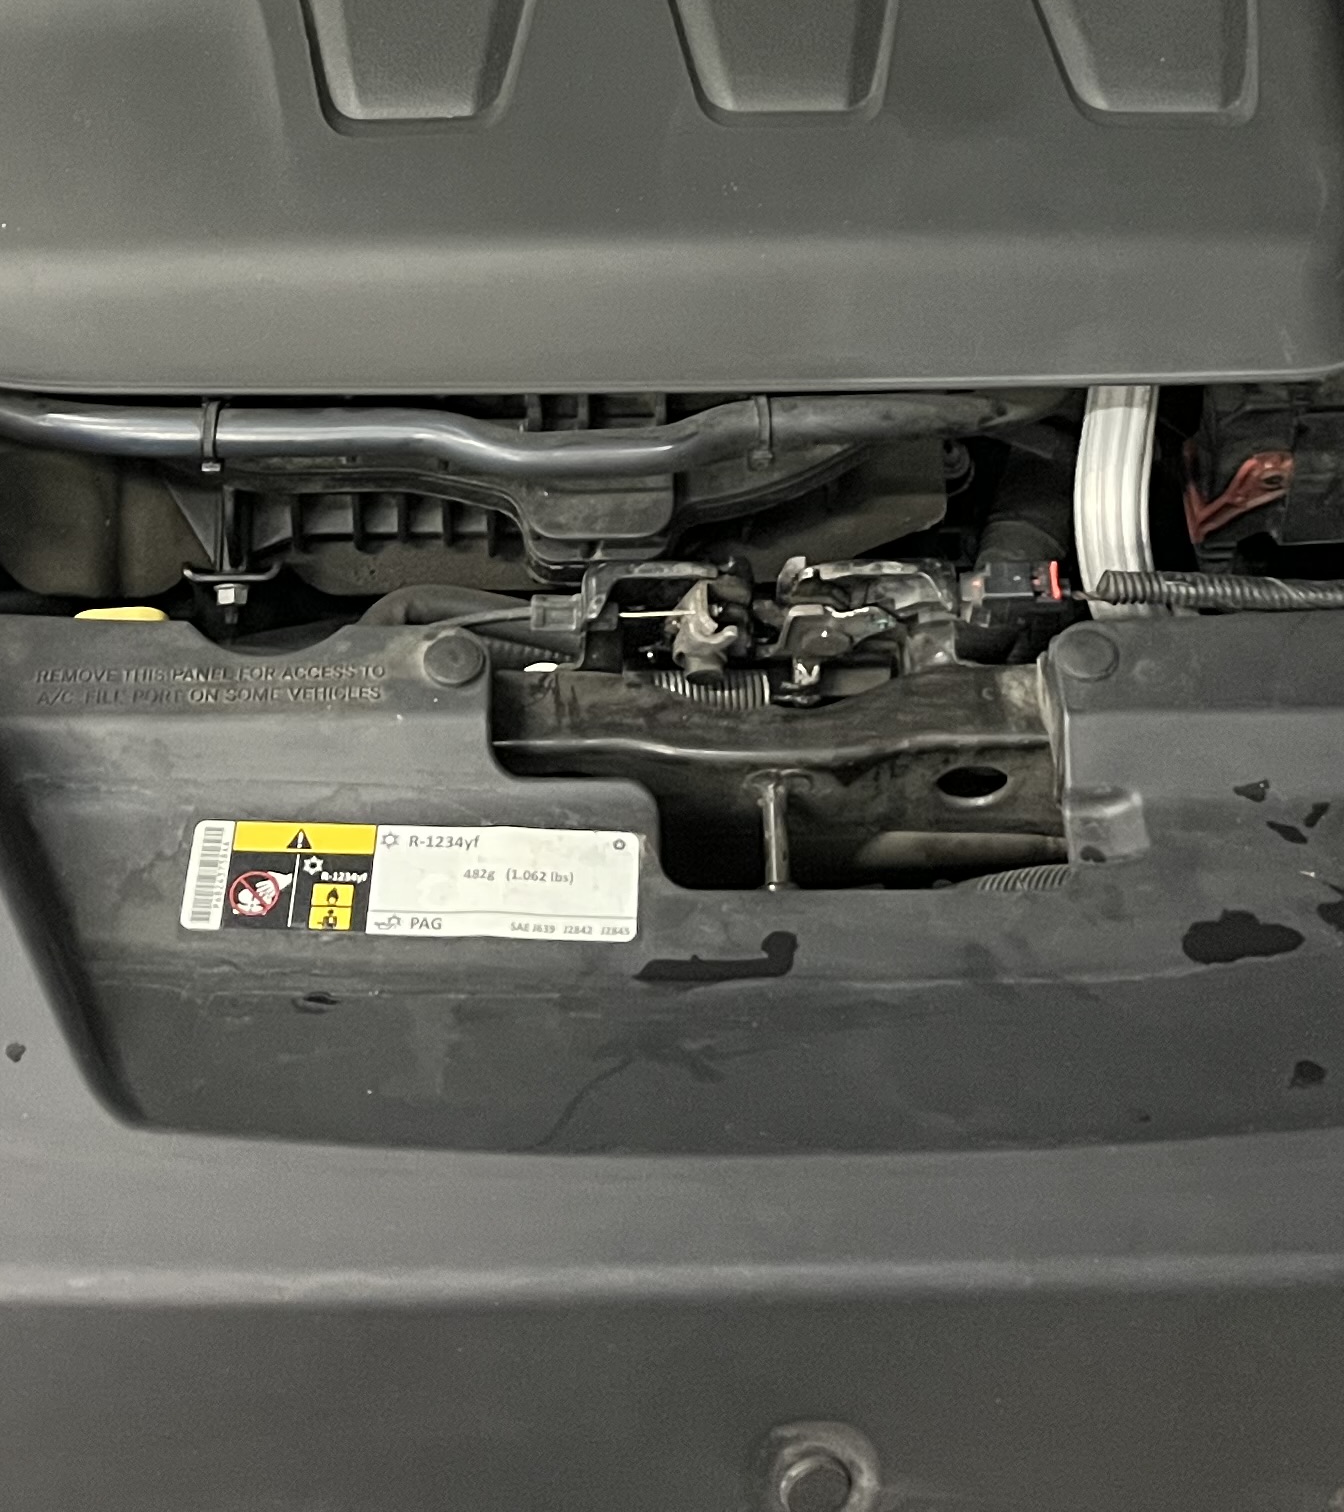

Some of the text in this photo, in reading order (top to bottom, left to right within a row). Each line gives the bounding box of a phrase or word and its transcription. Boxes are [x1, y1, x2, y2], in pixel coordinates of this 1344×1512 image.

[36, 668, 118, 683] REMOVE
[171, 666, 233, 682] PANEL
[236, 666, 275, 681] FOR
[282, 665, 356, 680] ACCESS
[360, 664, 386, 679] TO
[36, 690, 74, 707] A/C
[189, 688, 219, 703] ON
[224, 688, 279, 703] SOME
[287, 686, 382, 702] VEHICLES
[409, 835, 481, 851] R-1234yf
[463, 868, 574, 885] 482g (1.062 lbs)
[410, 917, 443, 931] PAG
[510, 921, 530, 933] SAE
